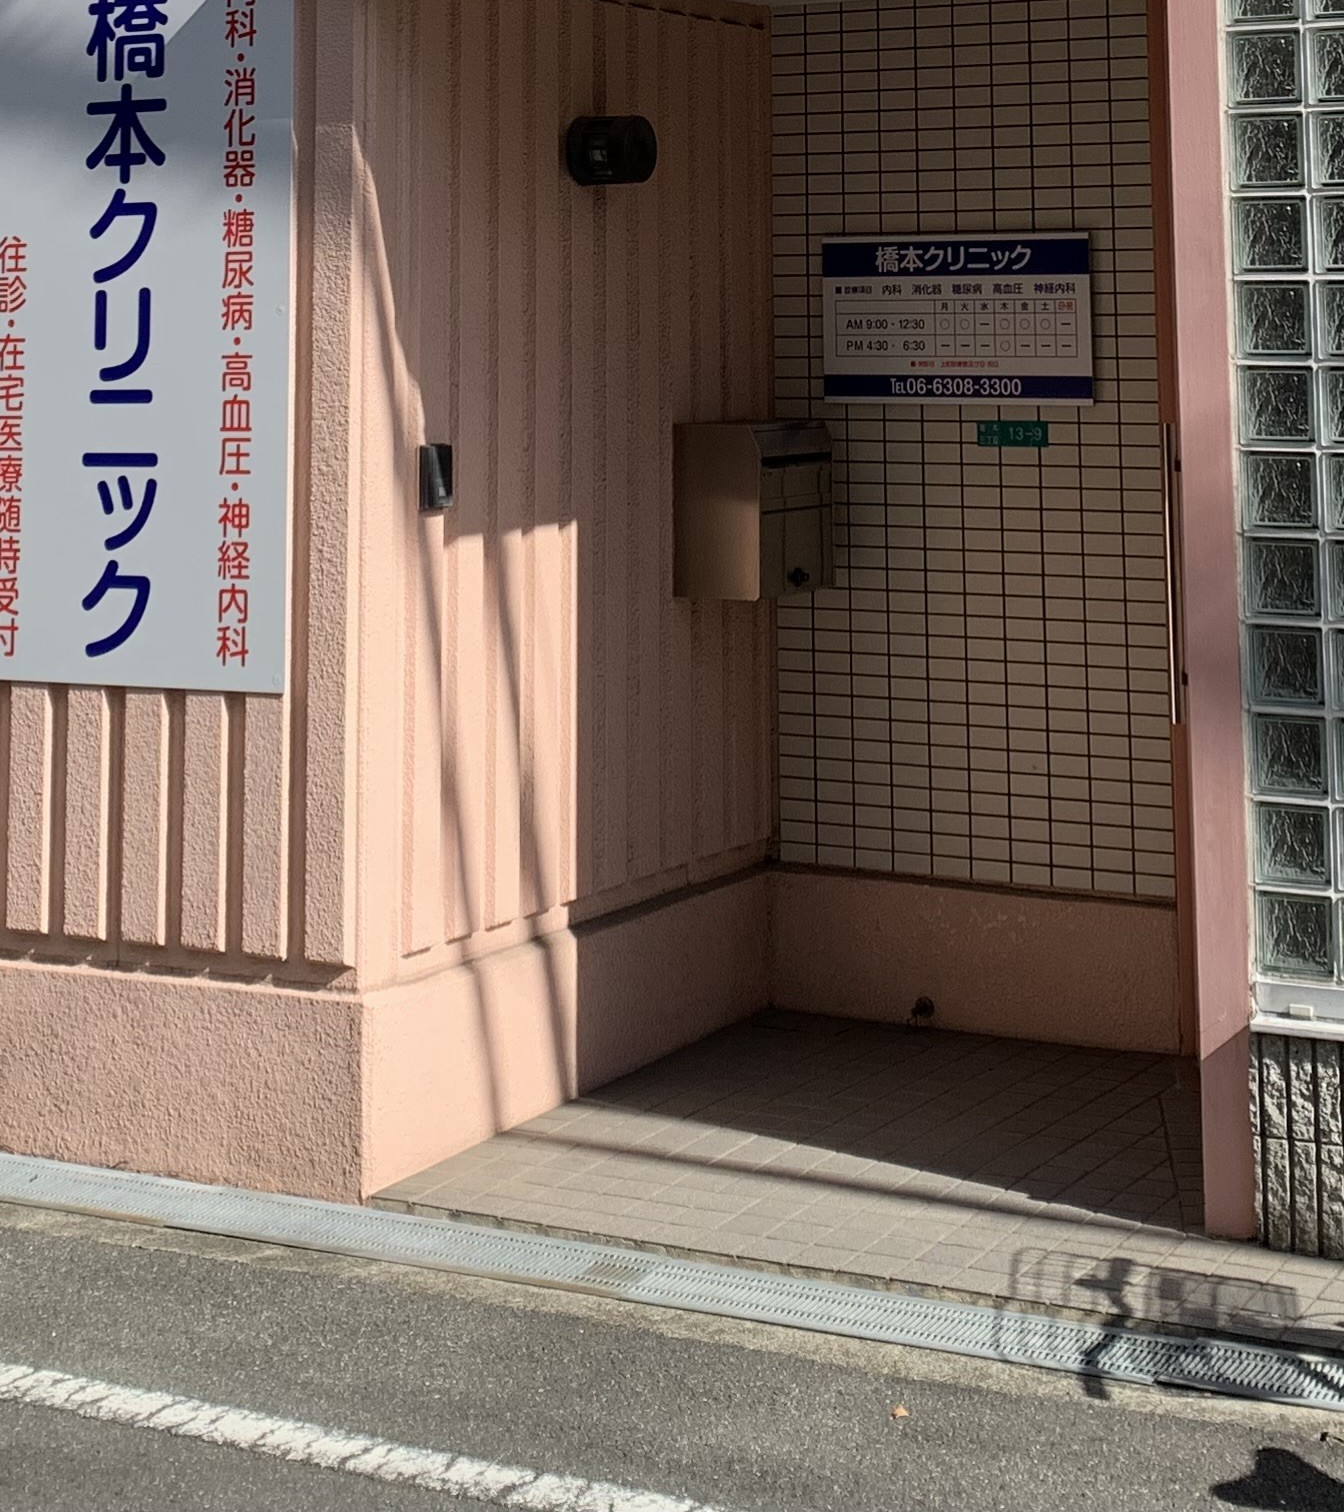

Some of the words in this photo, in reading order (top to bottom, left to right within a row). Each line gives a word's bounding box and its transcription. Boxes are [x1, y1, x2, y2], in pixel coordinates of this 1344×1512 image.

[875, 244, 1032, 273] 橋本クリニック
[846, 319, 863, 330] AM
[866, 319, 888, 330] 9:00
[899, 319, 925, 330] 12:30
[846, 340, 863, 351] PM
[866, 340, 888, 351] 4:30
[903, 340, 926, 351] 6:30
